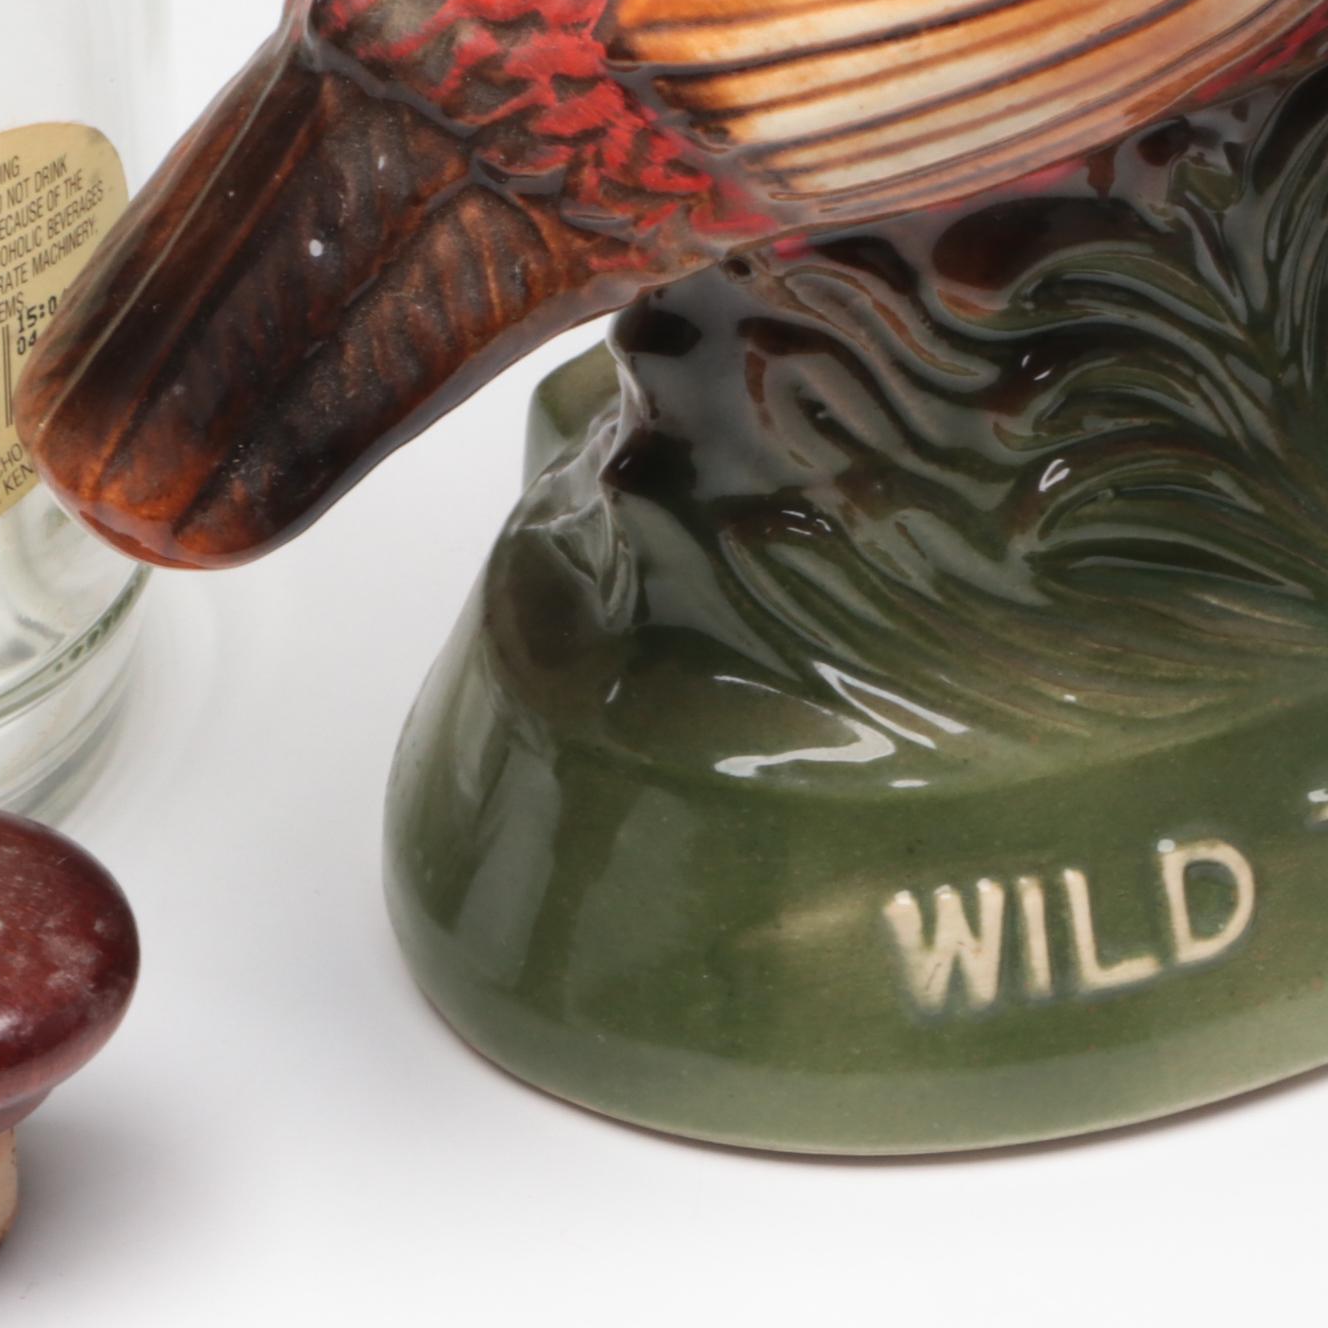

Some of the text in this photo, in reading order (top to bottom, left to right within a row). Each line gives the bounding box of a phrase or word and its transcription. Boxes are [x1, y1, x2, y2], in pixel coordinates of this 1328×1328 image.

[6, 177, 31, 210] NOT
[34, 153, 68, 194] DRINK
[47, 185, 60, 212] OF
[63, 168, 83, 200] THE
[47, 180, 104, 240] BEVERAGES
[883, 836, 1257, 1016] WILD
